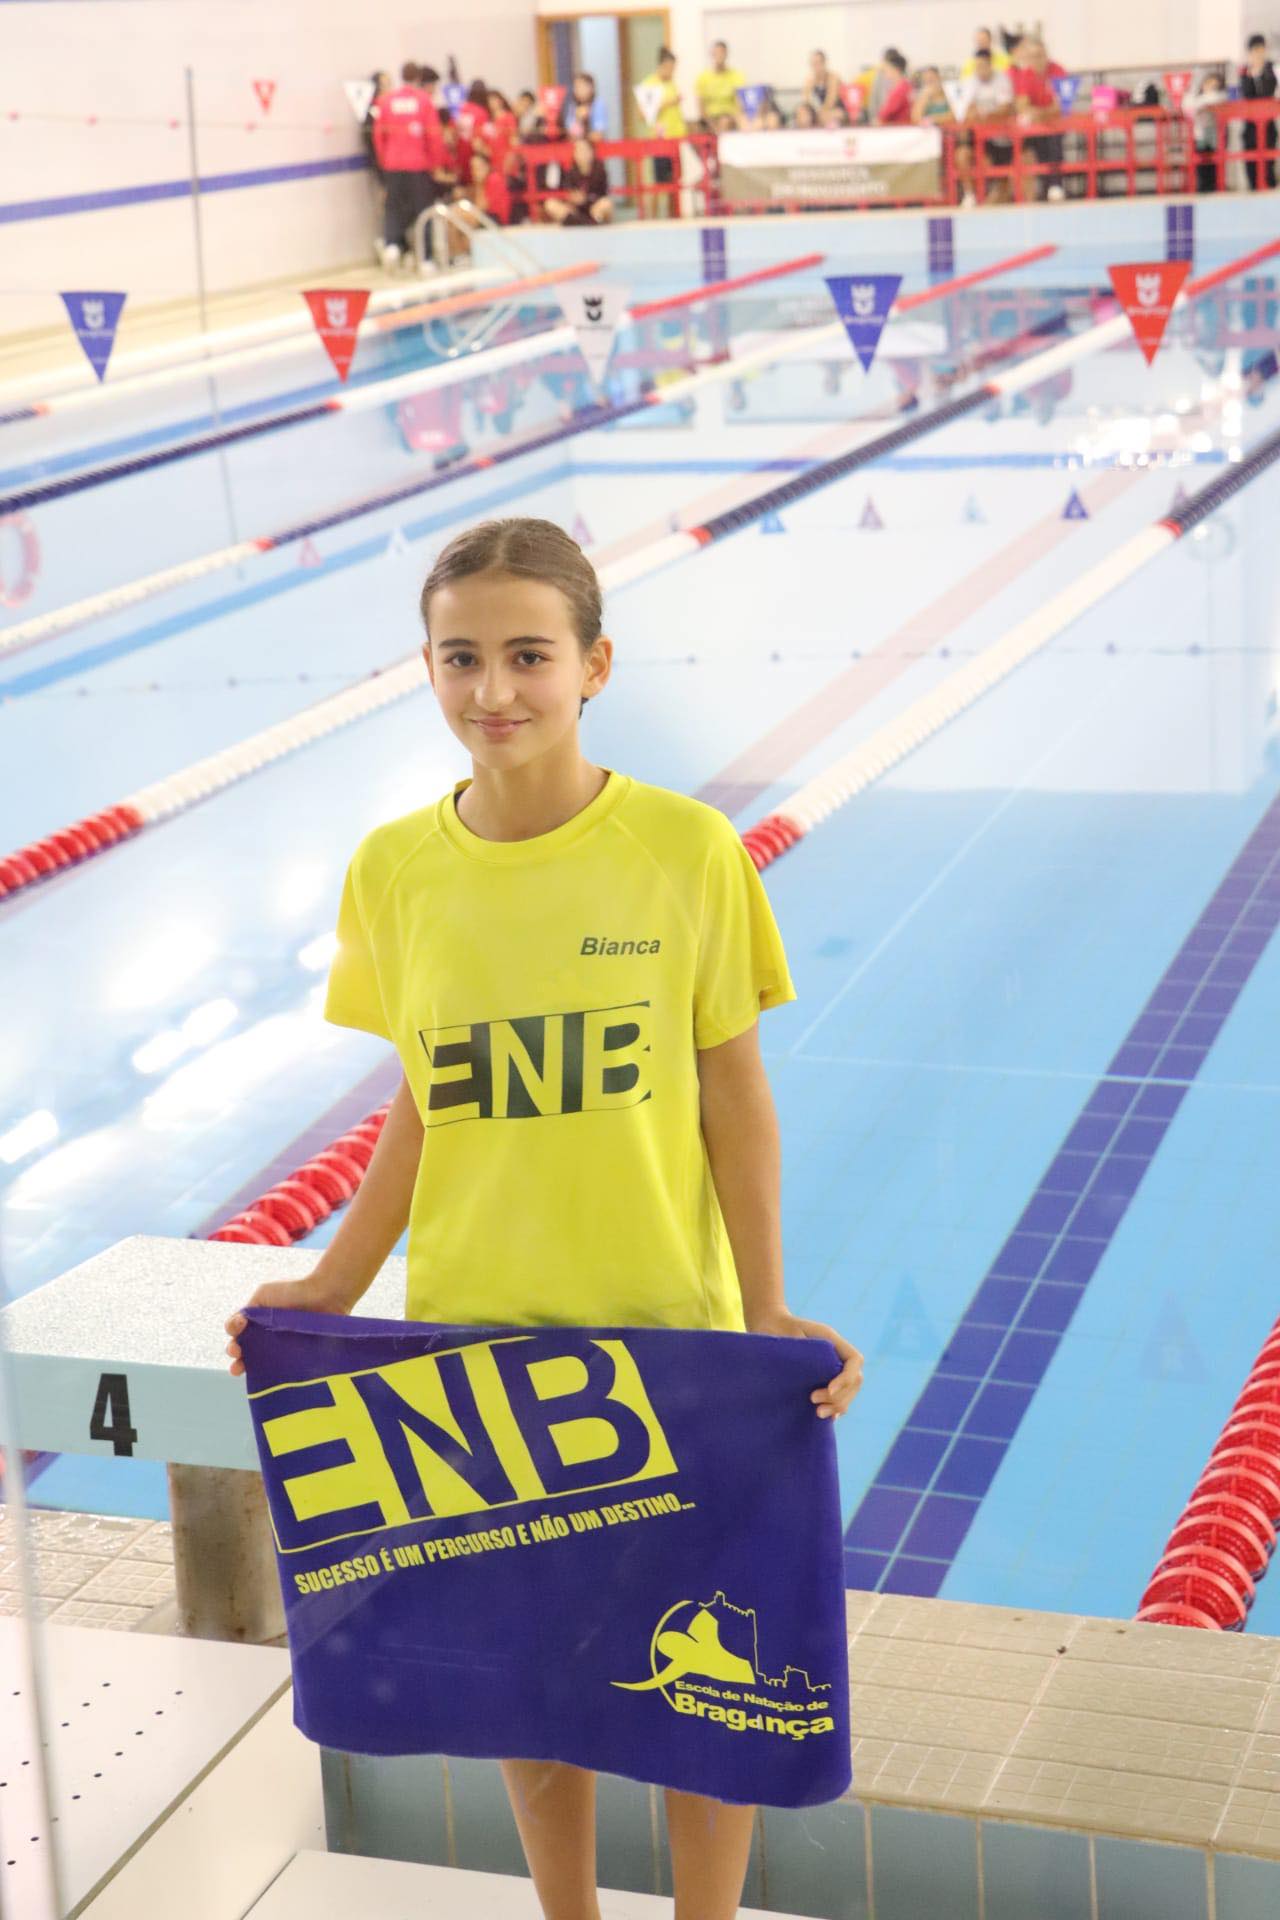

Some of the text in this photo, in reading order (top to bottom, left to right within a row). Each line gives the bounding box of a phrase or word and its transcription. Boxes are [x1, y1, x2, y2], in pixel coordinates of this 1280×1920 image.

[580, 937, 661, 956] Bianca
[419, 1001, 652, 1127] ENB
[90, 1373, 138, 1457] 4
[248, 1338, 668, 1551] ENB
[294, 1492, 696, 1594] SUCESSO É UM PERCURSO E NÃO UM DESTINO...
[675, 1680, 829, 1712] Escola de Natação de
